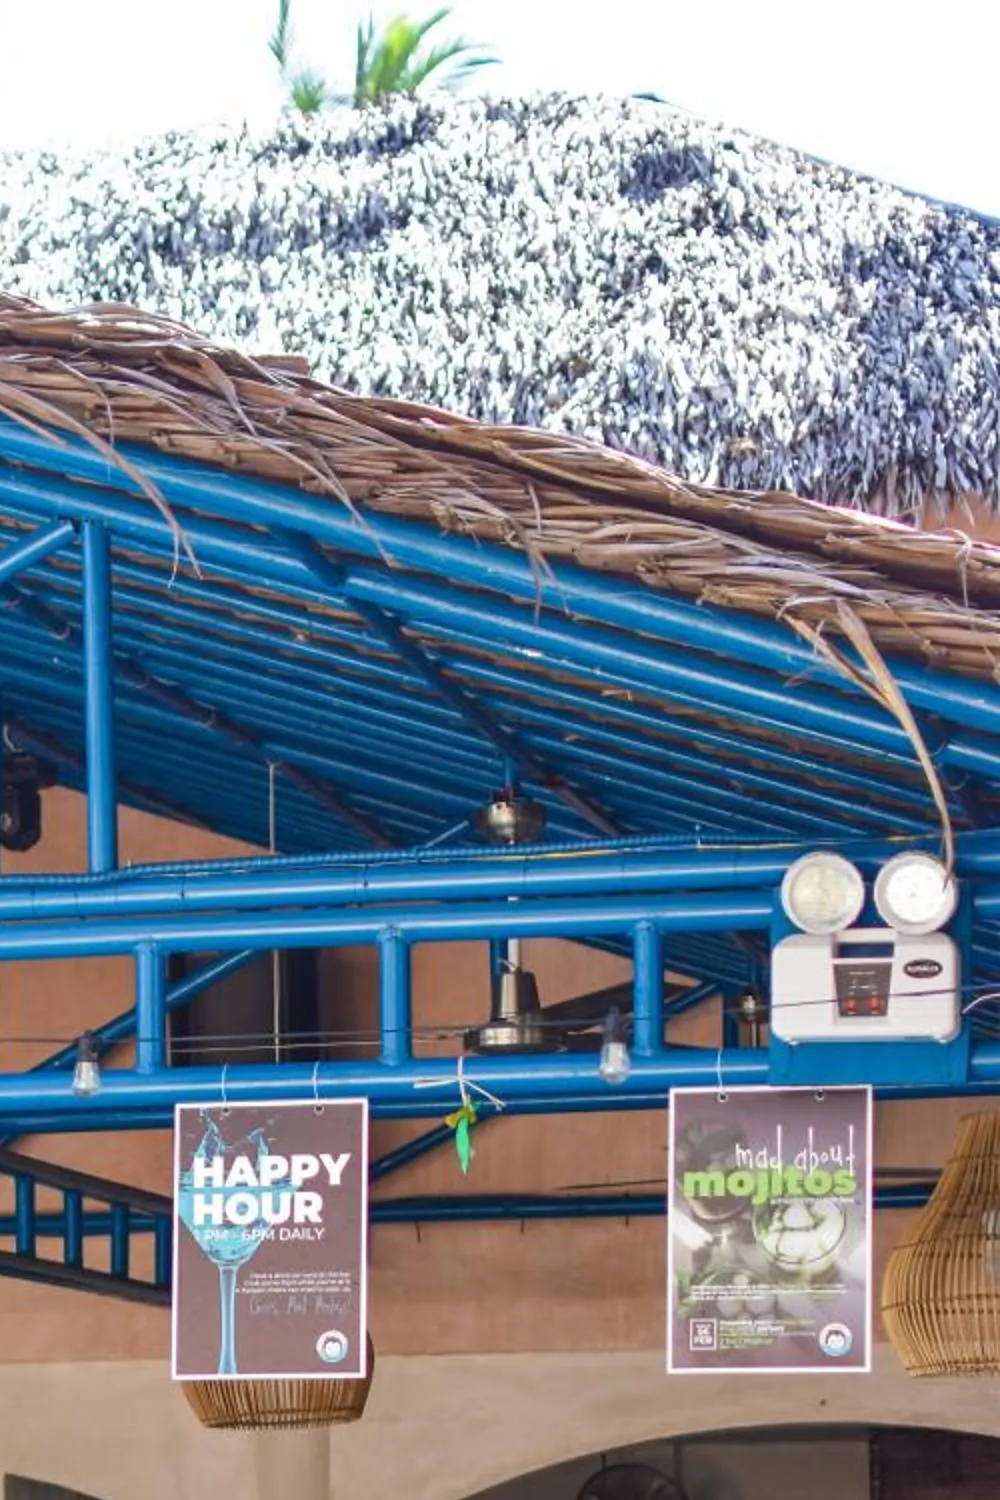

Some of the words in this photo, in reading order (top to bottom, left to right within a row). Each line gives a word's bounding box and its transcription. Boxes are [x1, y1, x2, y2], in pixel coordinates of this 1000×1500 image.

[735, 1124, 782, 1170] mad
[794, 1124, 855, 1176] about
[193, 1153, 351, 1188] HAPPY
[683, 1166, 857, 1205] mojitos
[193, 1191, 323, 1225] HOUR
[279, 1227, 326, 1241] DAILY
